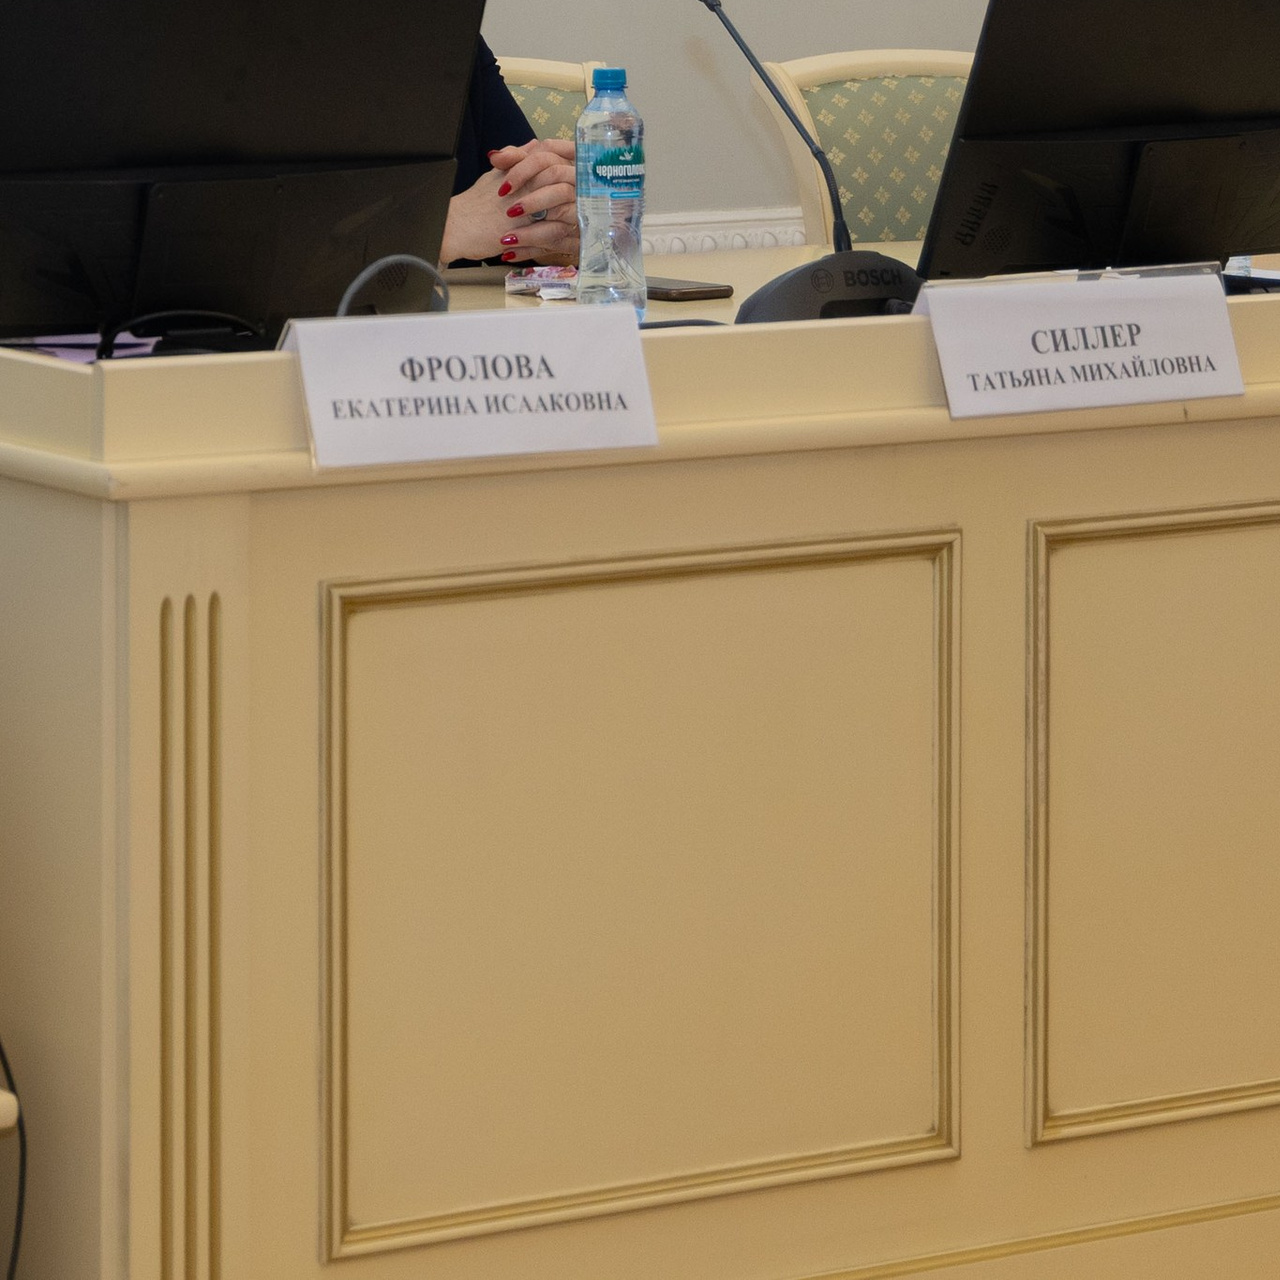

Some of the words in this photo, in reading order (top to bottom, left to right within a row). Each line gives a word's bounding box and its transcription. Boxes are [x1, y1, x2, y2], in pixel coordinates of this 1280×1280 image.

[844, 268, 903, 287] BOSCH
[1030, 322, 1142, 356] СИЛЛЕР
[399, 353, 556, 383] ФРОЛОВА
[966, 367, 1067, 393] ТАТЬЯНА
[1071, 354, 1218, 385] МИХАЙЛОВНА
[331, 396, 478, 420] ЕКАТЕРИНА
[485, 390, 629, 415] ИСААКОВНА
